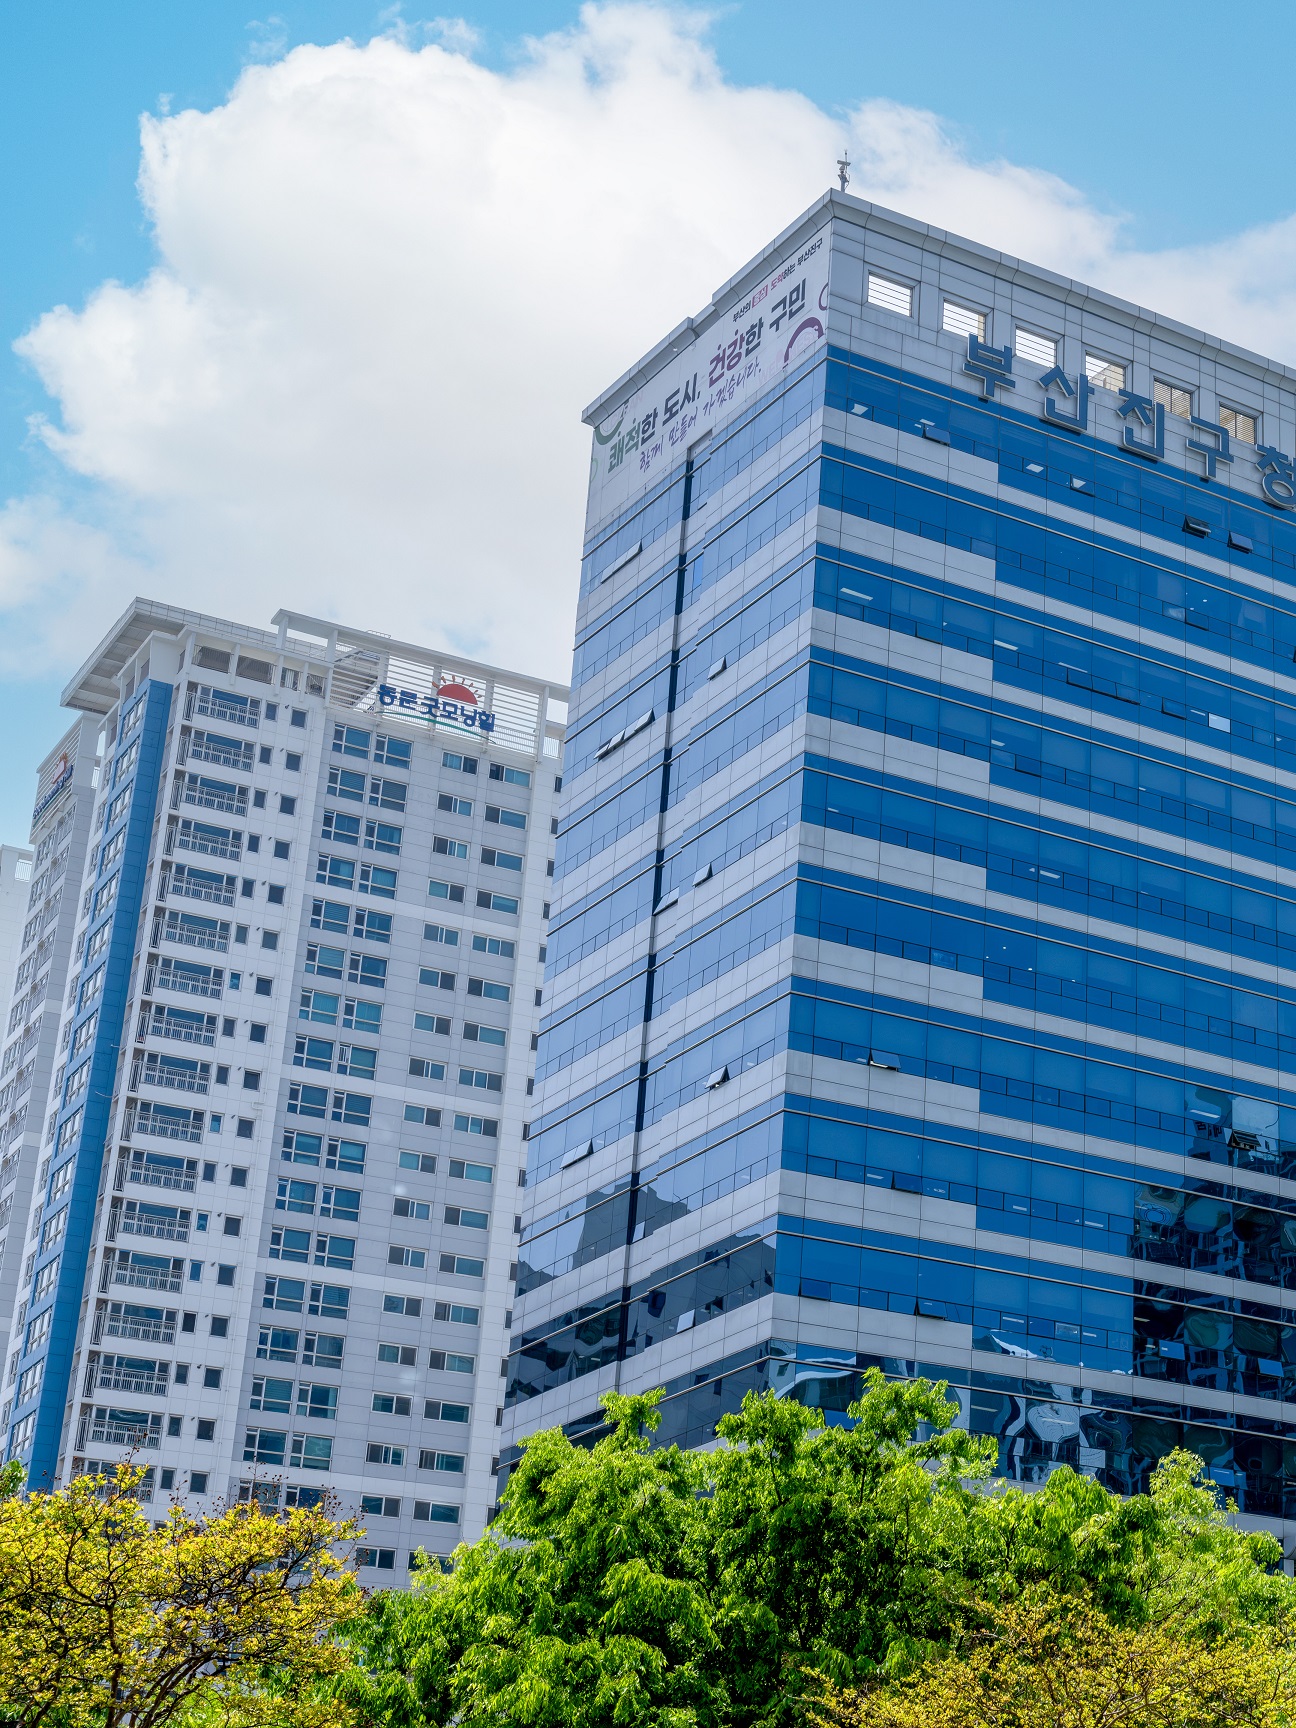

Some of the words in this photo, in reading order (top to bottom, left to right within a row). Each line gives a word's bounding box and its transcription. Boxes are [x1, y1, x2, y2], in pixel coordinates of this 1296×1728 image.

[797, 238, 823, 266] 부산진구
[608, 407, 659, 474] 쾌적한
[708, 317, 764, 389] 건강한
[769, 278, 806, 332] 구민
[640, 434, 664, 473] 함께
[668, 406, 698, 447] 만들어
